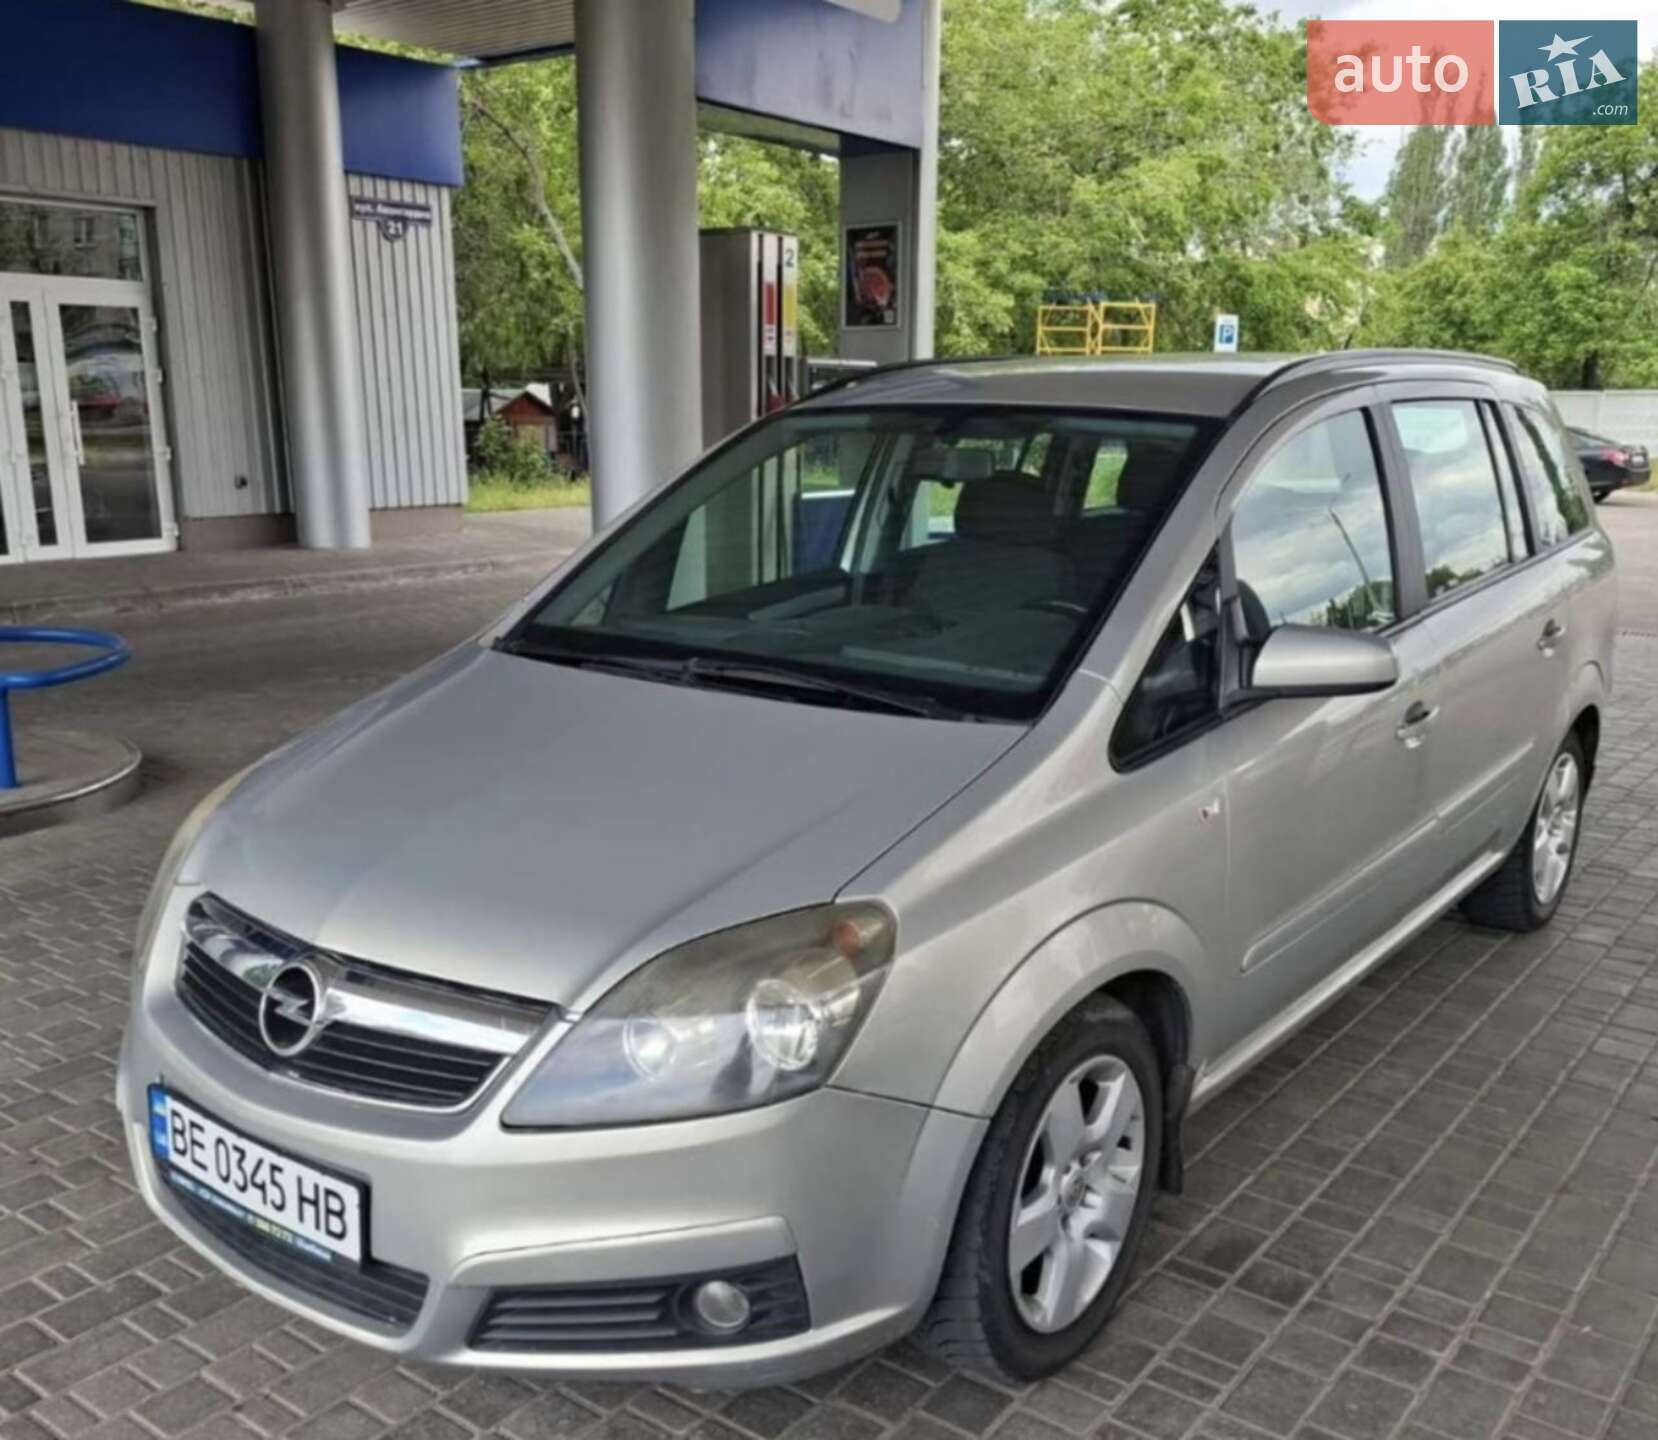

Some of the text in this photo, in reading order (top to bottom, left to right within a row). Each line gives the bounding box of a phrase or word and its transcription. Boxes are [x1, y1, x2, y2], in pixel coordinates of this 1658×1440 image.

[387, 220, 403, 235] 21
[784, 248, 795, 268] 2
[171, 1110, 208, 1172] BE
[214, 1136, 286, 1213] 0345
[297, 1175, 347, 1242] HB
